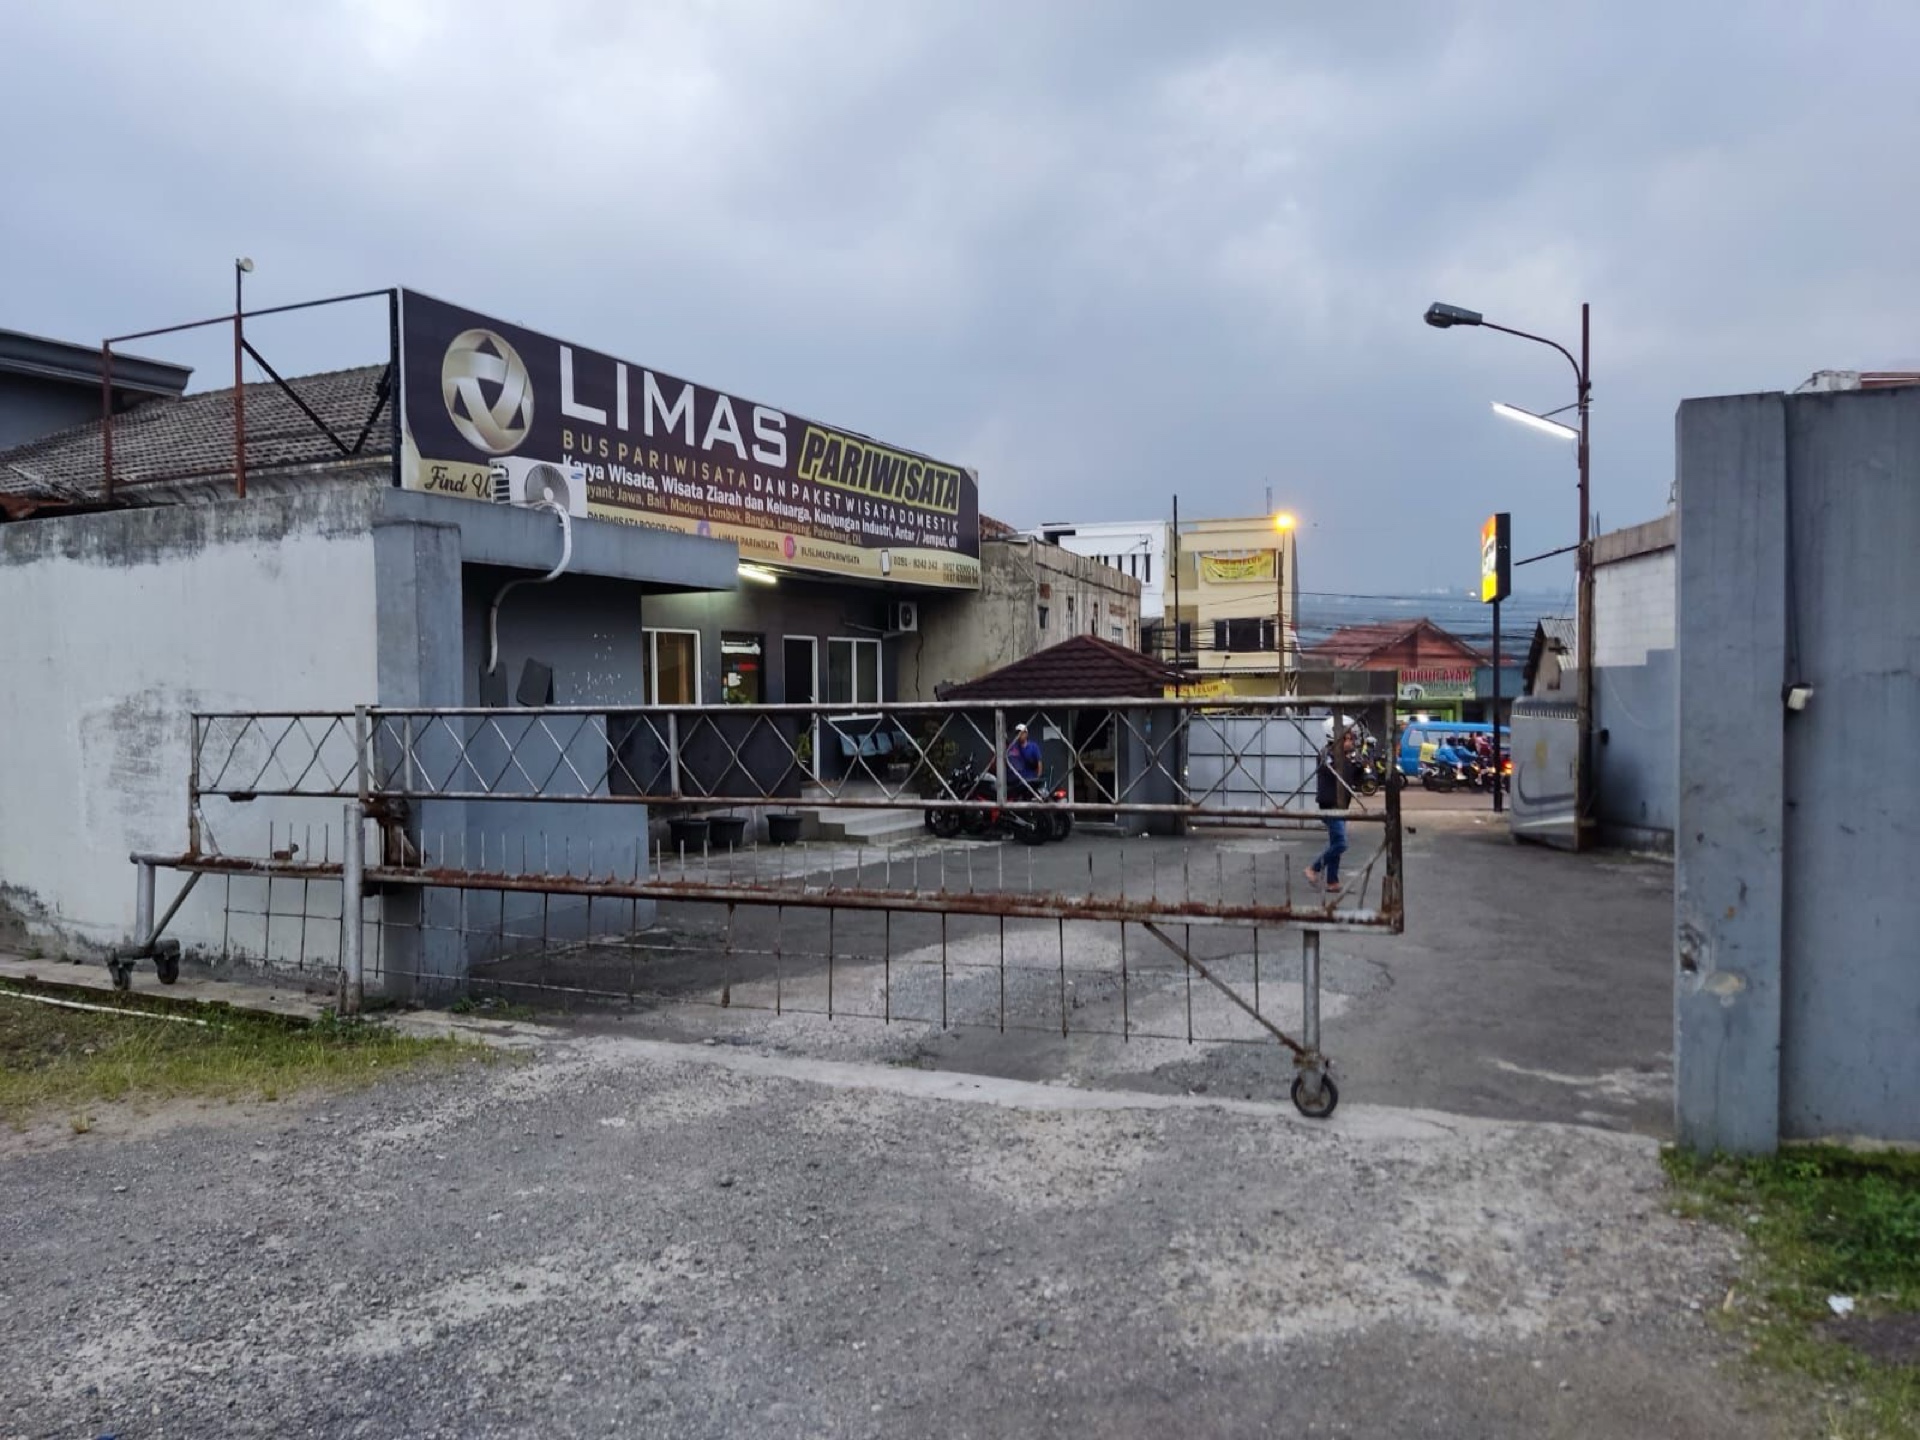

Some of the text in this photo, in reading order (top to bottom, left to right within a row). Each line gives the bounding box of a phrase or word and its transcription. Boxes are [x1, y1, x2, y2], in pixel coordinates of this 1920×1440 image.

[560, 345, 960, 515] LIMAS PARIWISATA
[425, 465, 492, 499] Find U
[562, 430, 958, 534] BUS PARIWISATA DAN PAKET WISATA DOMESTIK
[608, 467, 659, 493] Wisata,
[661, 474, 704, 500] Wisata
[706, 485, 742, 506] Ziarah
[744, 494, 764, 511] dan
[766, 498, 812, 524] Keluarga,
[814, 507, 860, 532] Kunjungan
[863, 519, 893, 541] Industri,
[895, 528, 915, 541] Antar
[647, 493, 668, 511] Bali,
[1443, 670, 1471, 682] AYAM
